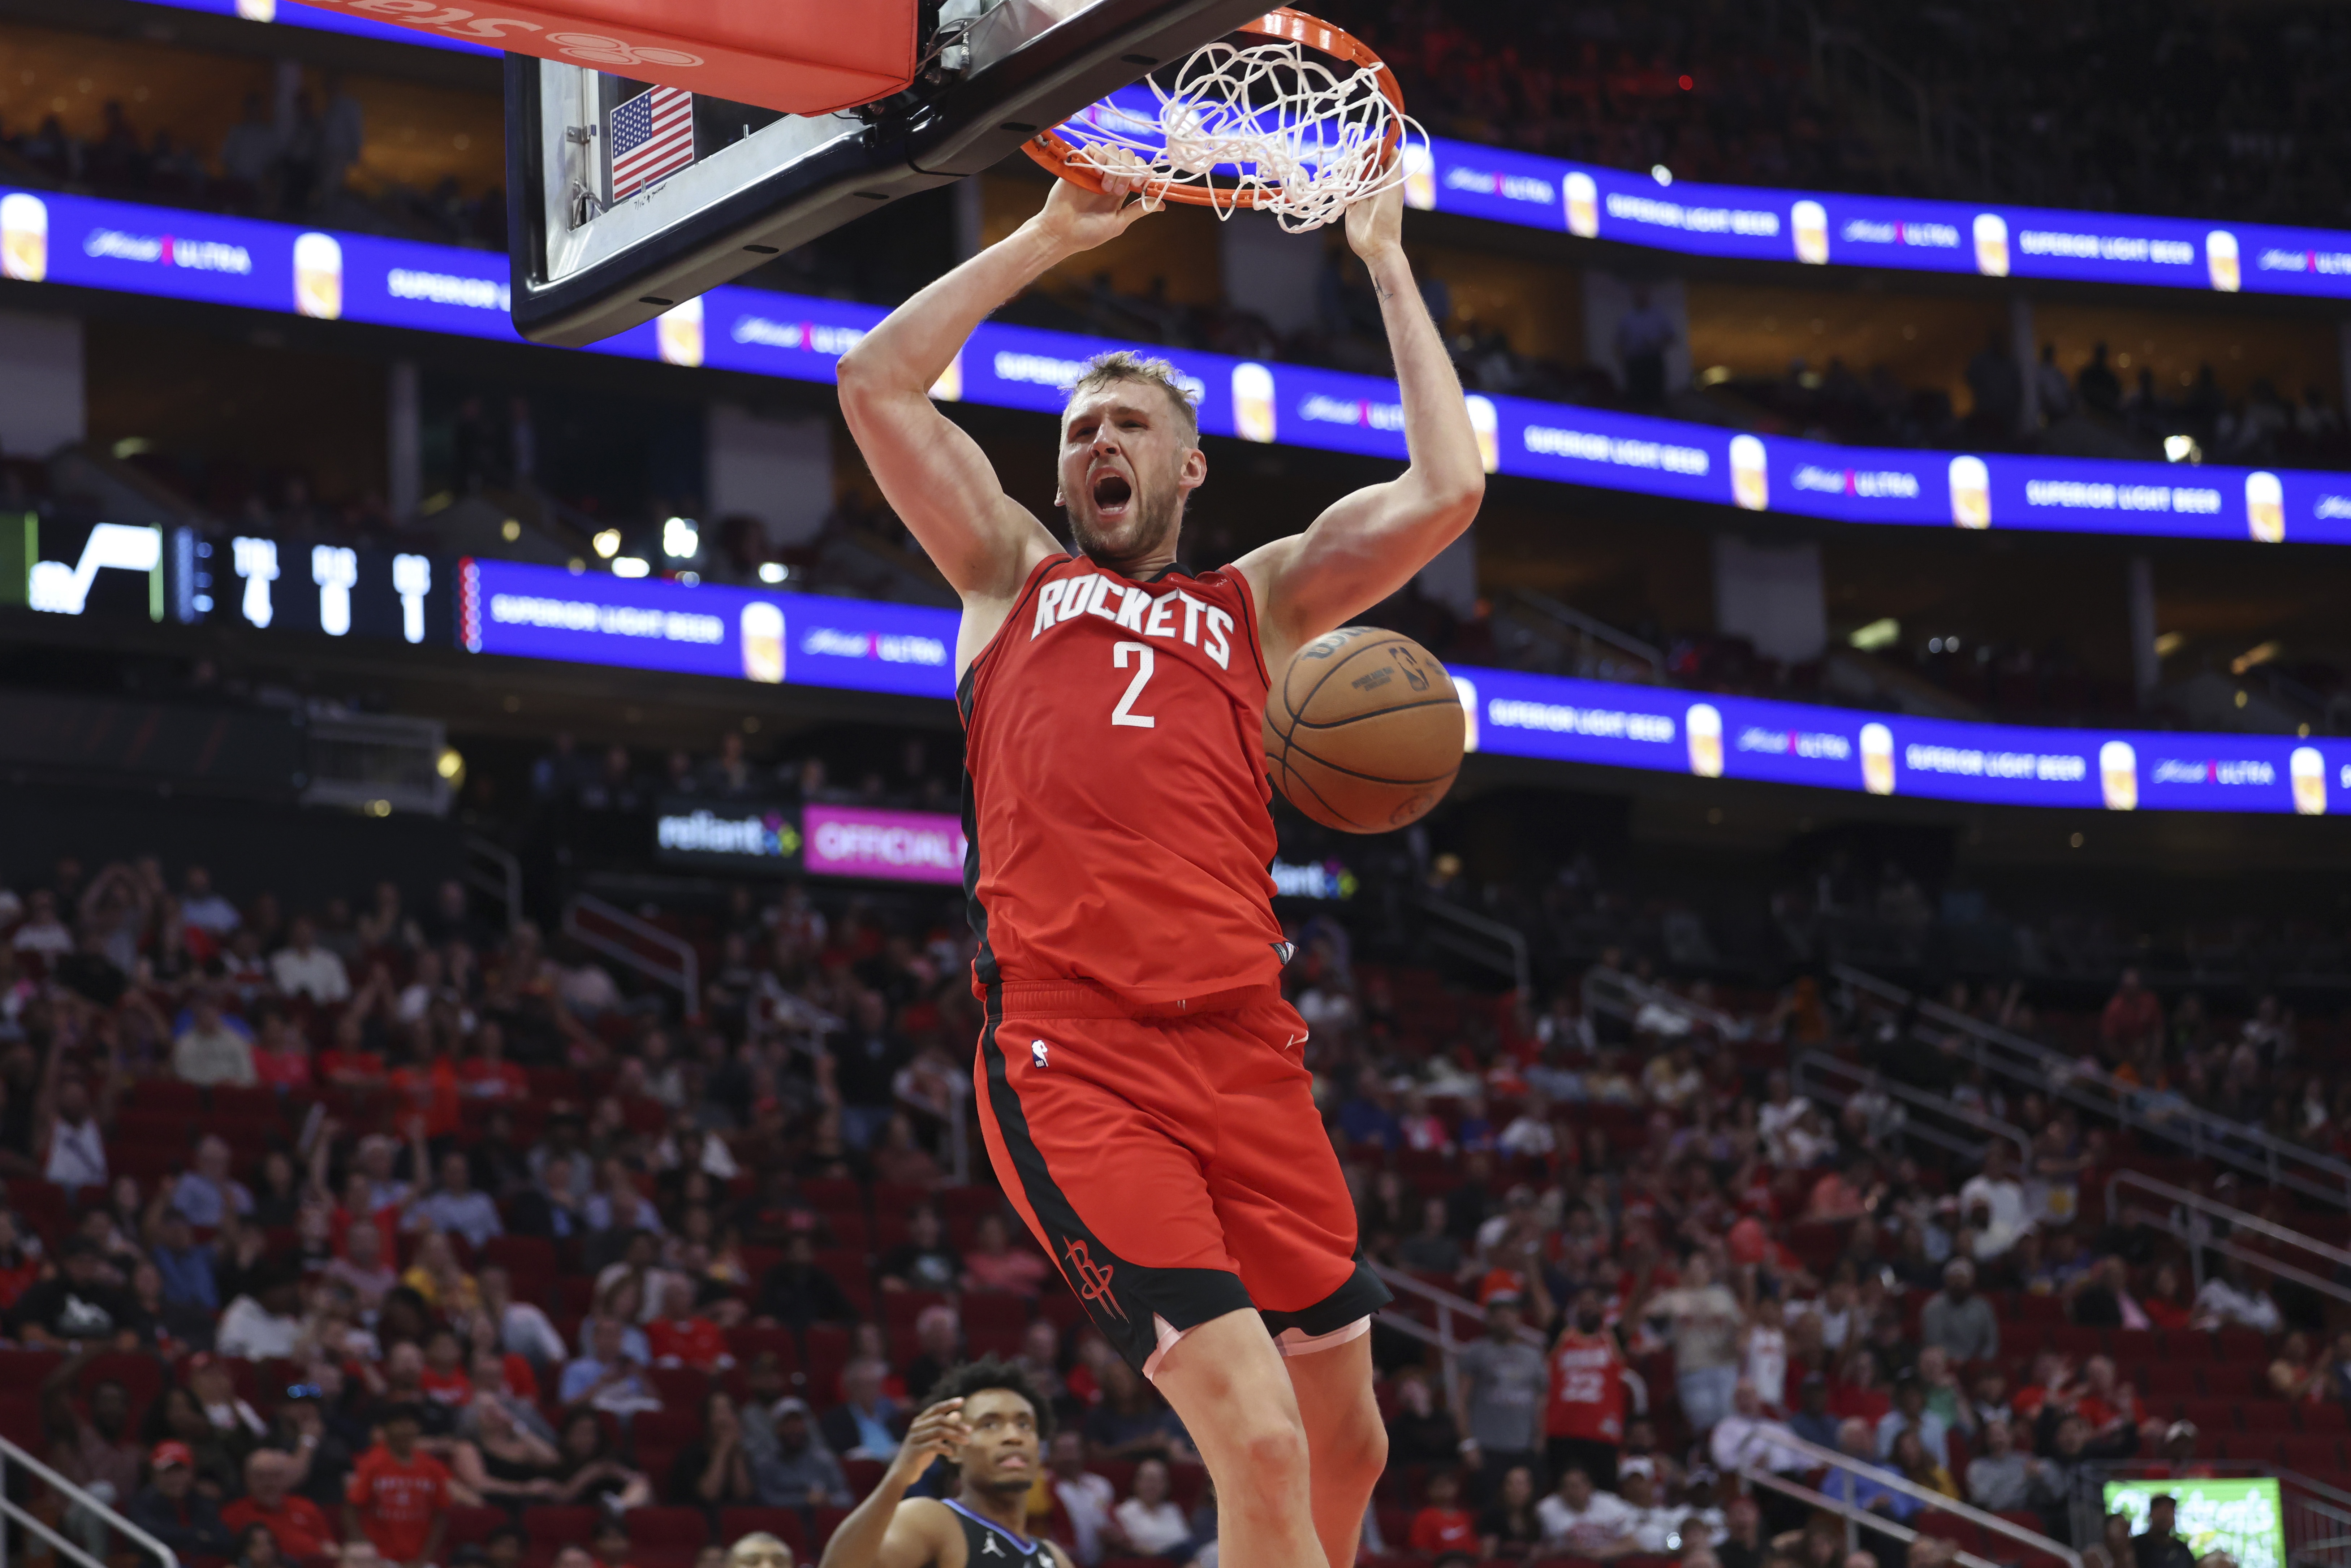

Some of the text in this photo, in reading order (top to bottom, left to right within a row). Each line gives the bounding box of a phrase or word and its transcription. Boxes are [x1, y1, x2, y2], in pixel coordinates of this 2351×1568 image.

[1030, 573, 1234, 671] ROCKETS
[1112, 641, 1155, 728] 2
[658, 809, 766, 855] reliant
[815, 822, 954, 868] OFFICIAL
